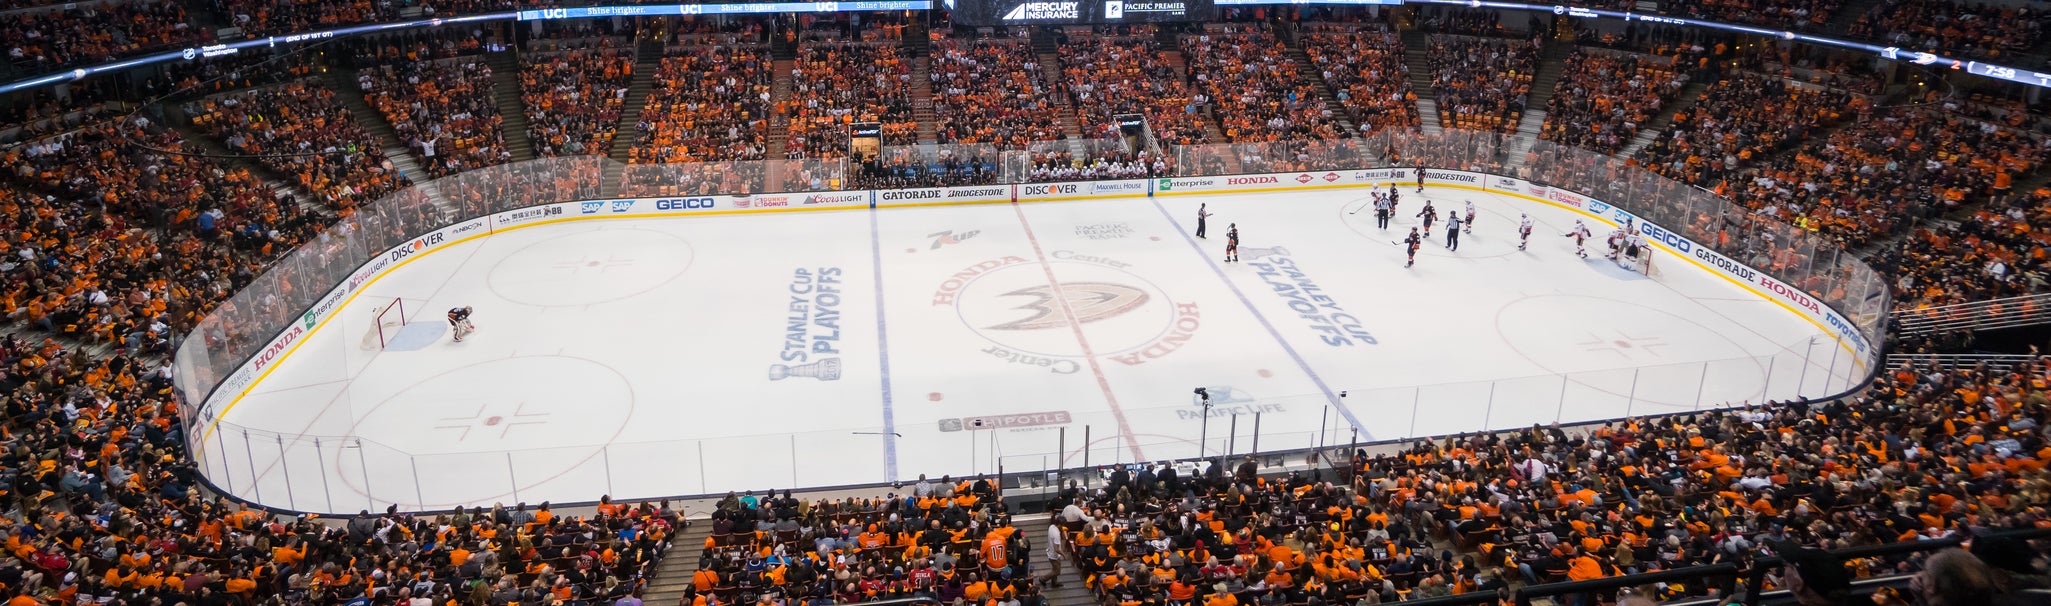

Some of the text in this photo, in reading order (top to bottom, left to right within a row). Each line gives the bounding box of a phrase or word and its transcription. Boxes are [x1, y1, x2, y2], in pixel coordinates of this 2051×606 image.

[612, 7, 646, 15] brighter.
[680, 4, 702, 14] UCI
[744, 4, 777, 12] brighter.
[816, 2, 838, 12] UCI
[1026, 2, 1078, 10] MERCURY
[544, 9, 567, 18] UCI
[202, 43, 226, 52] Toronto
[203, 48, 238, 58] Washington
[1951, 60, 1961, 70] 2
[1986, 65, 2016, 79] 7:58
[1228, 176, 1278, 185] HONDA
[1427, 172, 1477, 183] RIDGESTONE
[1164, 179, 1213, 188] enterprise
[883, 190, 941, 200] GATORADE
[948, 188, 1004, 198] BRIDGESTONE
[1026, 184, 1077, 195] DISCOVER
[656, 198, 714, 210] GEICO
[814, 194, 840, 204] Coors
[1558, 198, 1581, 207] DONUTS
[552, 207, 562, 215] 88
[582, 204, 599, 213] SAP
[612, 203, 630, 212] SAP
[1590, 202, 1606, 213] SAP
[1641, 222, 1691, 253] GEICO
[391, 232, 444, 262] DISCOVER
[1695, 248, 1756, 282] GATORADE
[353, 258, 389, 288] Coors LIGHT
[932, 250, 1133, 307] HONDA Center
[1268, 256, 1378, 345] STANLEY CUP
[1760, 276, 1821, 315] HONDA
[306, 288, 346, 324] enterprise
[1247, 262, 1354, 347] PLAYOFFS
[780, 267, 813, 362] STANLEY CUP
[812, 267, 842, 354] PLAYOFFS
[981, 301, 1200, 375] HONDA Center
[254, 326, 303, 372] HONDA
[1176, 403, 1287, 420] PACIFIC LIFE
[991, 545, 1005, 560] 17
